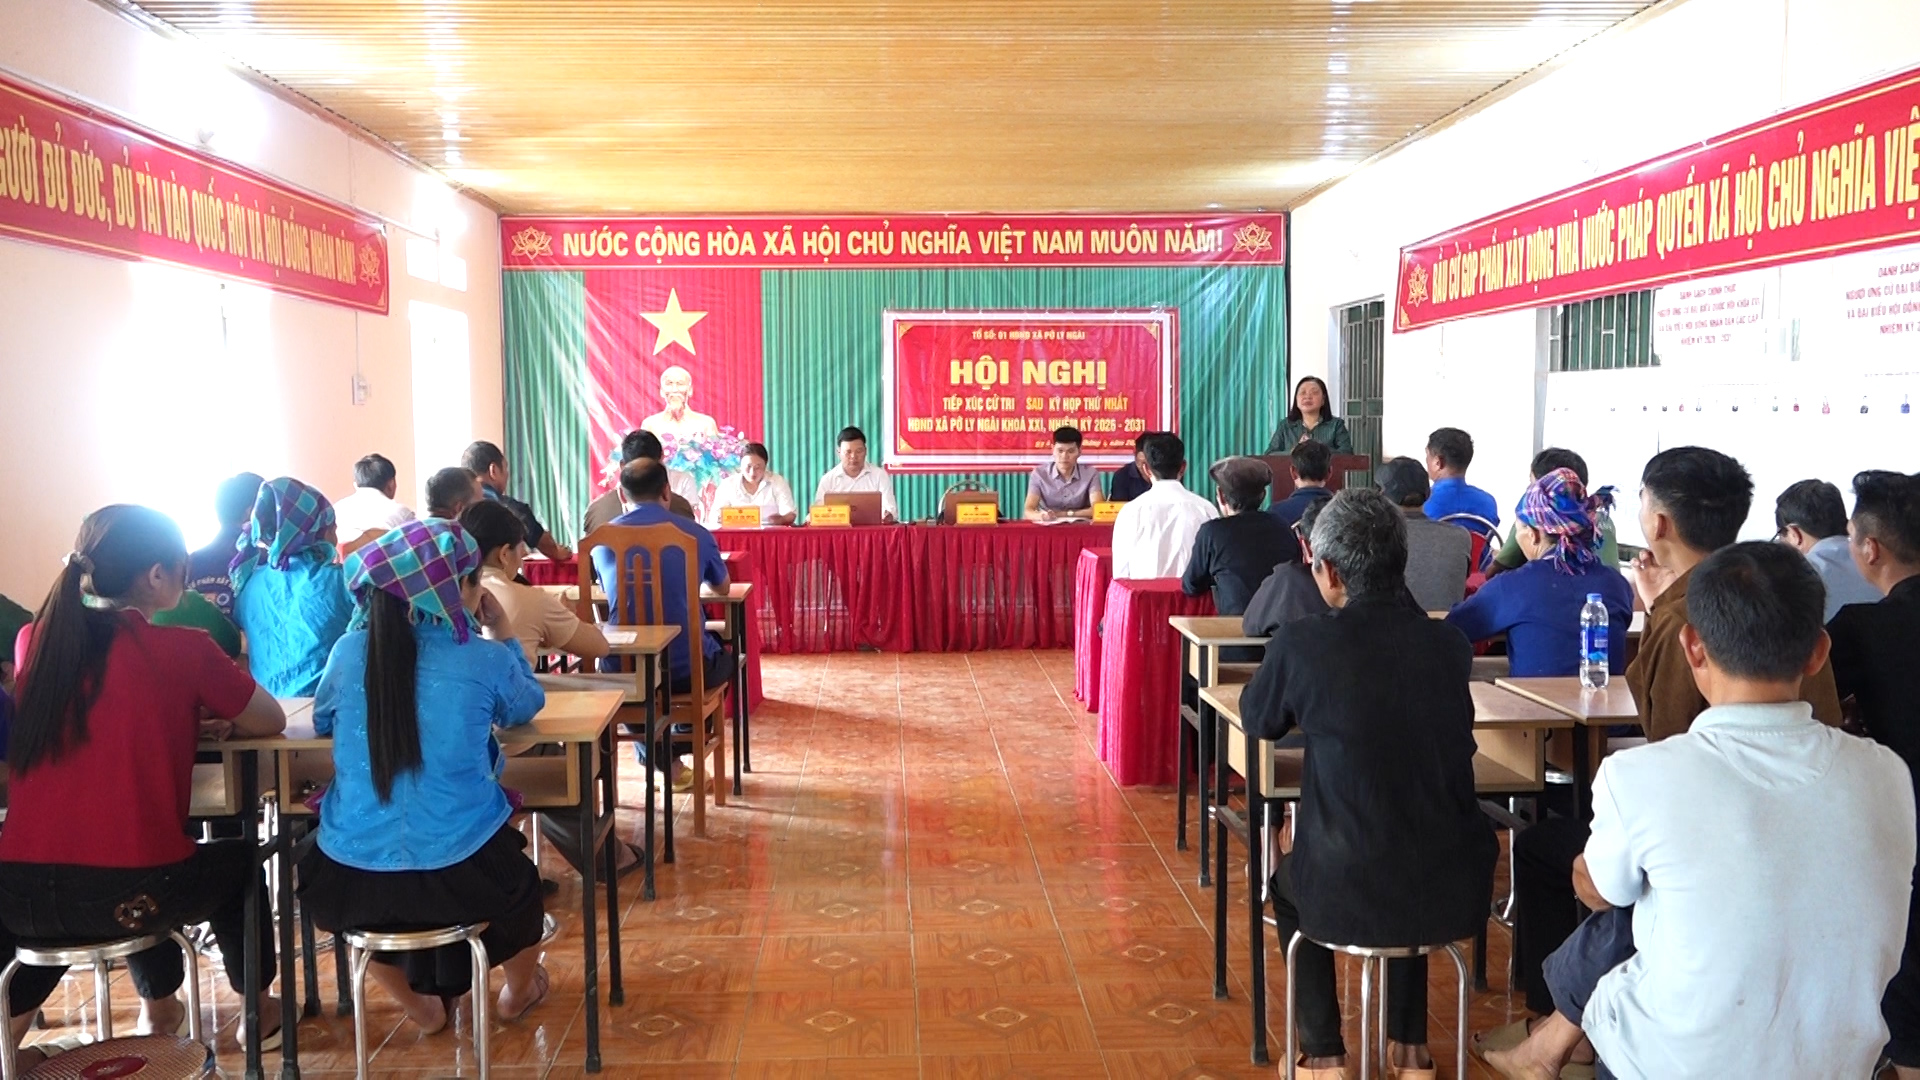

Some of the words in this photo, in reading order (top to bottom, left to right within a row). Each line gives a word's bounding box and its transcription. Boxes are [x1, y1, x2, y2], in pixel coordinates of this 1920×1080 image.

[41, 121, 68, 212] ĐỦ
[71, 140, 112, 231] ĐỨC,
[112, 145, 136, 230] ĐỦ
[136, 161, 162, 236] TÀI
[162, 169, 191, 244] VÀO
[192, 176, 226, 253] QUỐC
[226, 193, 248, 269] HỘI
[247, 199, 264, 262] VÀ
[263, 205, 283, 278] HỘI
[282, 205, 310, 274] ĐỒNG
[310, 223, 336, 280] NHÂN
[1432, 245, 1448, 305] BẦU
[1449, 241, 1462, 301] CỬ
[1461, 241, 1478, 298] GÓP
[1479, 227, 1504, 293] PHẦN
[1505, 227, 1525, 288] XÂY
[1525, 225, 1554, 294] DỰNG
[1556, 209, 1579, 276] NHÀ
[1581, 199, 1615, 271] NƯỚC
[1617, 187, 1653, 262] PHÁP
[1655, 163, 1705, 260] QUYỀN
[1707, 162, 1730, 243] XÃ
[1733, 152, 1764, 250] HỘI
[1767, 129, 1806, 231] CHỦ
[1810, 121, 1876, 222] NGHĨA
[563, 226, 628, 256] NƯỚC
[635, 225, 700, 264] CỘNG
[707, 225, 757, 256] HÒA
[763, 225, 796, 256] XÃ
[803, 224, 840, 263] HỘI
[847, 219, 894, 256] CHỦ
[901, 224, 972, 255] NGHĨA
[978, 223, 1025, 261] VIỆT
[1033, 230, 1083, 255] NAM
[1090, 223, 1158, 254] MUÔN
[1164, 222, 1223, 254] NĂM!
[950, 355, 1010, 390] HỘI
[1022, 358, 1107, 390] NGHỊ
[942, 393, 963, 411] TIẾP
[964, 395, 984, 411] XÚC
[985, 393, 1000, 411] CỬ
[1000, 397, 1016, 411] TRI
[1026, 397, 1044, 411] SAU
[1048, 395, 1061, 411] KỲ
[1063, 397, 1082, 413] HỌP
[1083, 395, 1102, 411] THỨ
[1104, 393, 1128, 411] NHẤT
[935, 415, 949, 432] XÃ
[950, 415, 963, 432] PỜ
[965, 417, 976, 432] LY
[977, 415, 1000, 432] NGÀI
[1028, 418, 1046, 433] XXI,
[1080, 416, 1092, 432] KỲ
[1094, 418, 1117, 432] 2026
[1124, 418, 1146, 432] 2031
